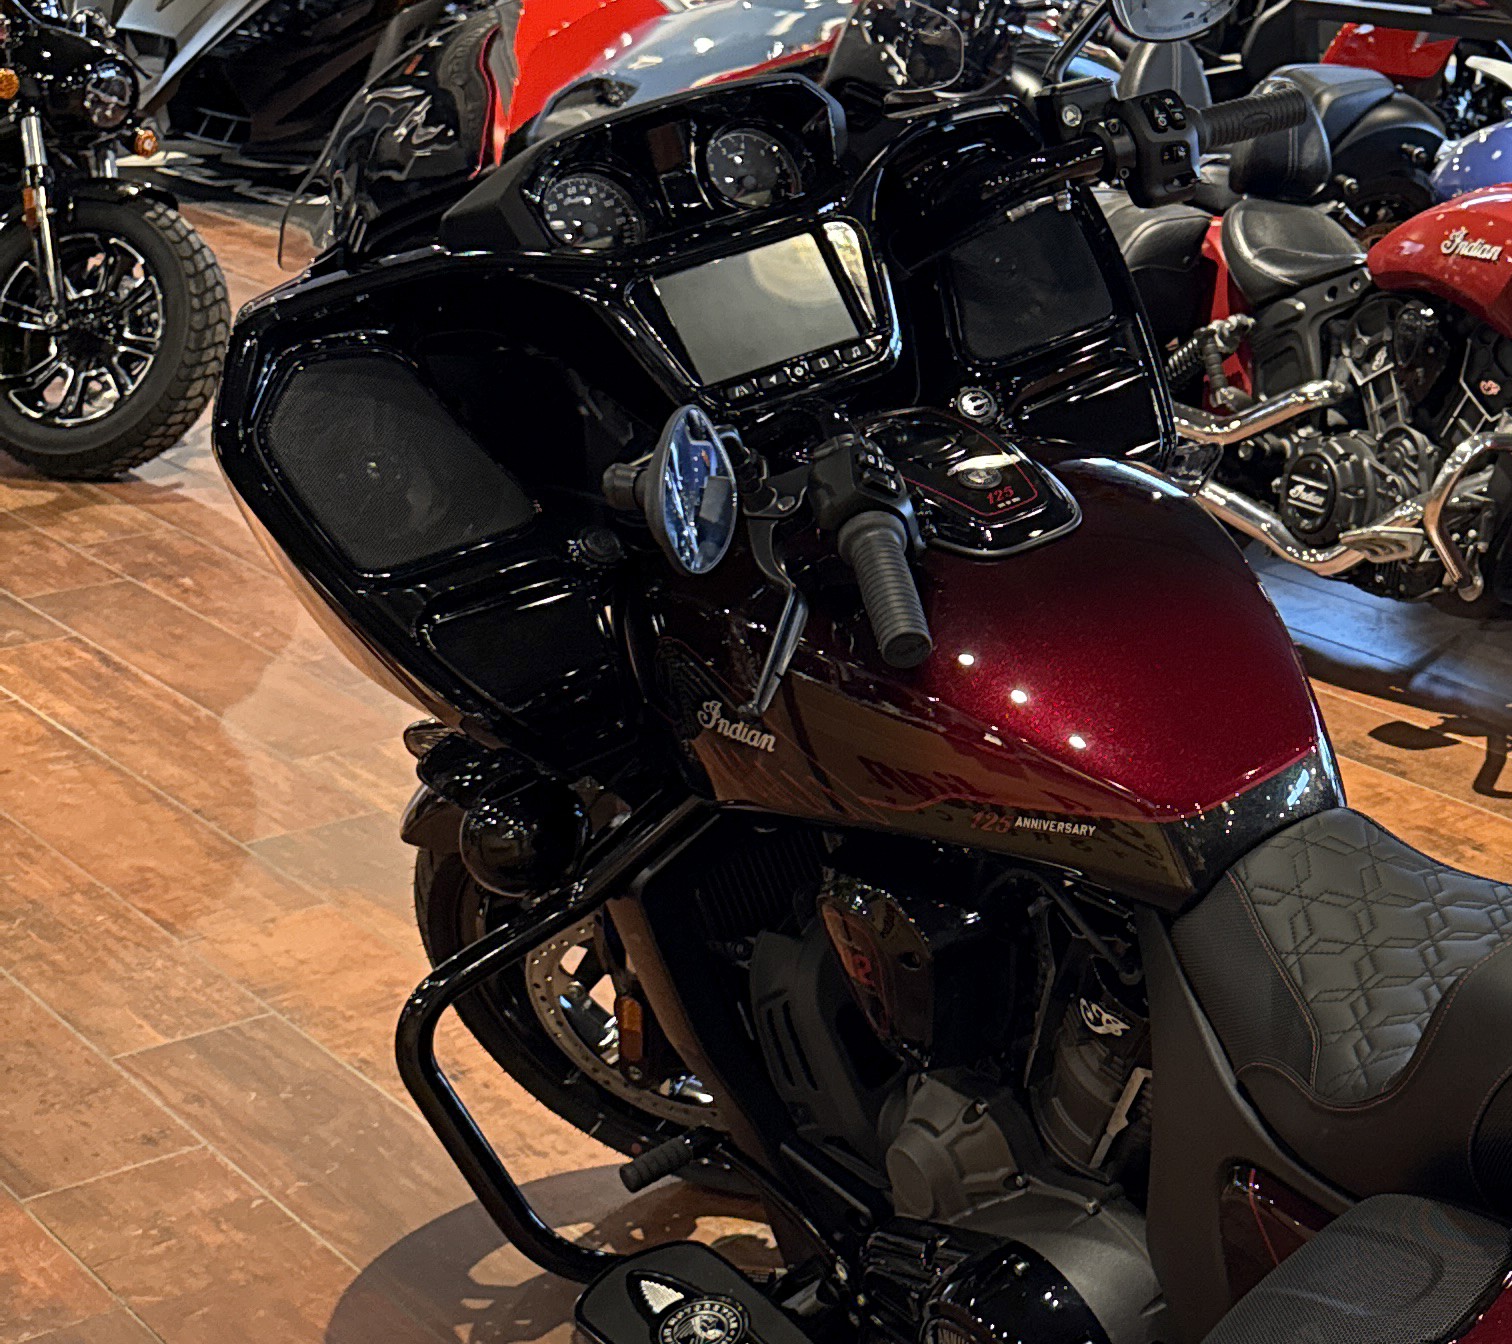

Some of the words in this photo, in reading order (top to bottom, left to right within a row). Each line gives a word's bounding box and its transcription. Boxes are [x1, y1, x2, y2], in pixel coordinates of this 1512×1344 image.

[1440, 228, 1503, 261] Indian
[987, 485, 1015, 505] 125
[697, 700, 776, 752] Indian
[969, 810, 1012, 834] 125
[1014, 815, 1097, 837] ANNIVERSARY
